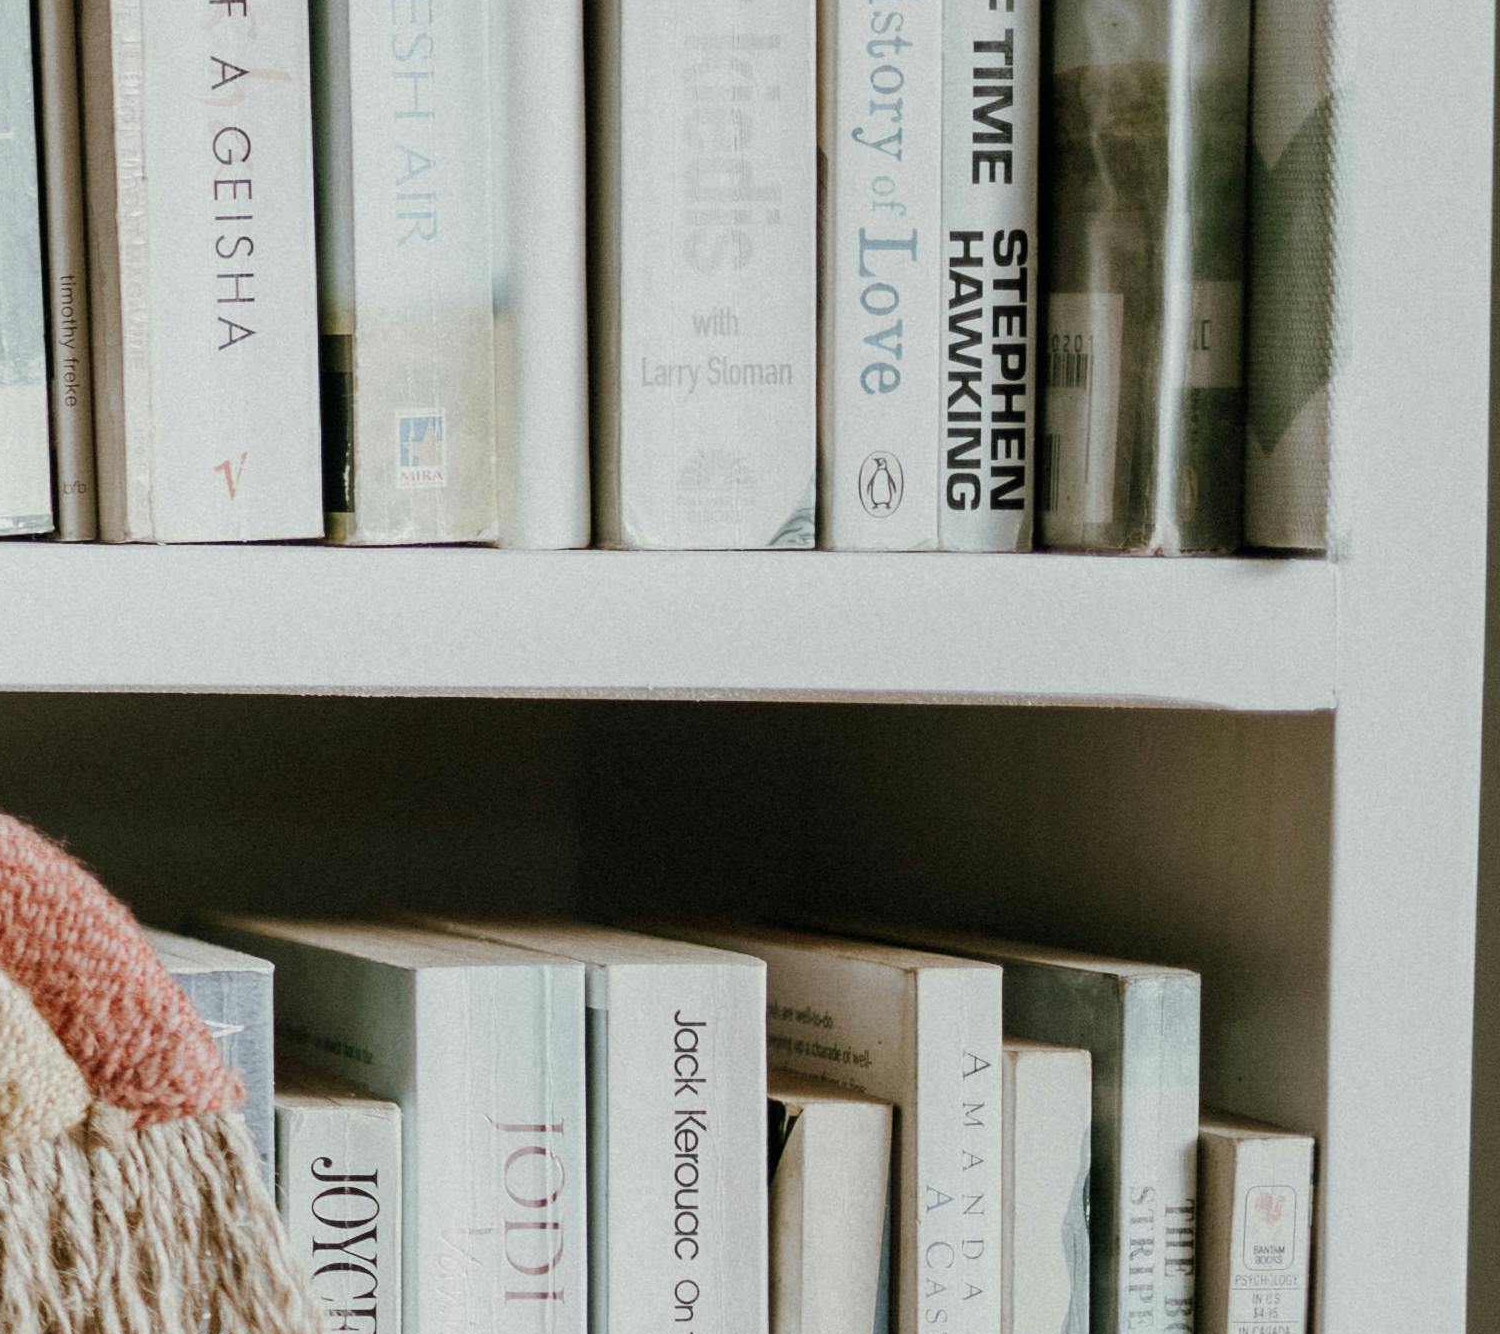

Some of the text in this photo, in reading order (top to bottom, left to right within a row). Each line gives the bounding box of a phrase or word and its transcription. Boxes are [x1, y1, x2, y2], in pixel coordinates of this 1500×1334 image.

[208, 55, 250, 91] A
[971, 28, 1015, 185] TIME
[211, 125, 257, 352] GEISHA
[946, 229, 984, 512] HAWKING
[990, 227, 1029, 511] STEPHEN
[672, 1008, 707, 1097] Jack
[672, 1109, 707, 1261] Kerouac
[673, 1278, 700, 1324] On
